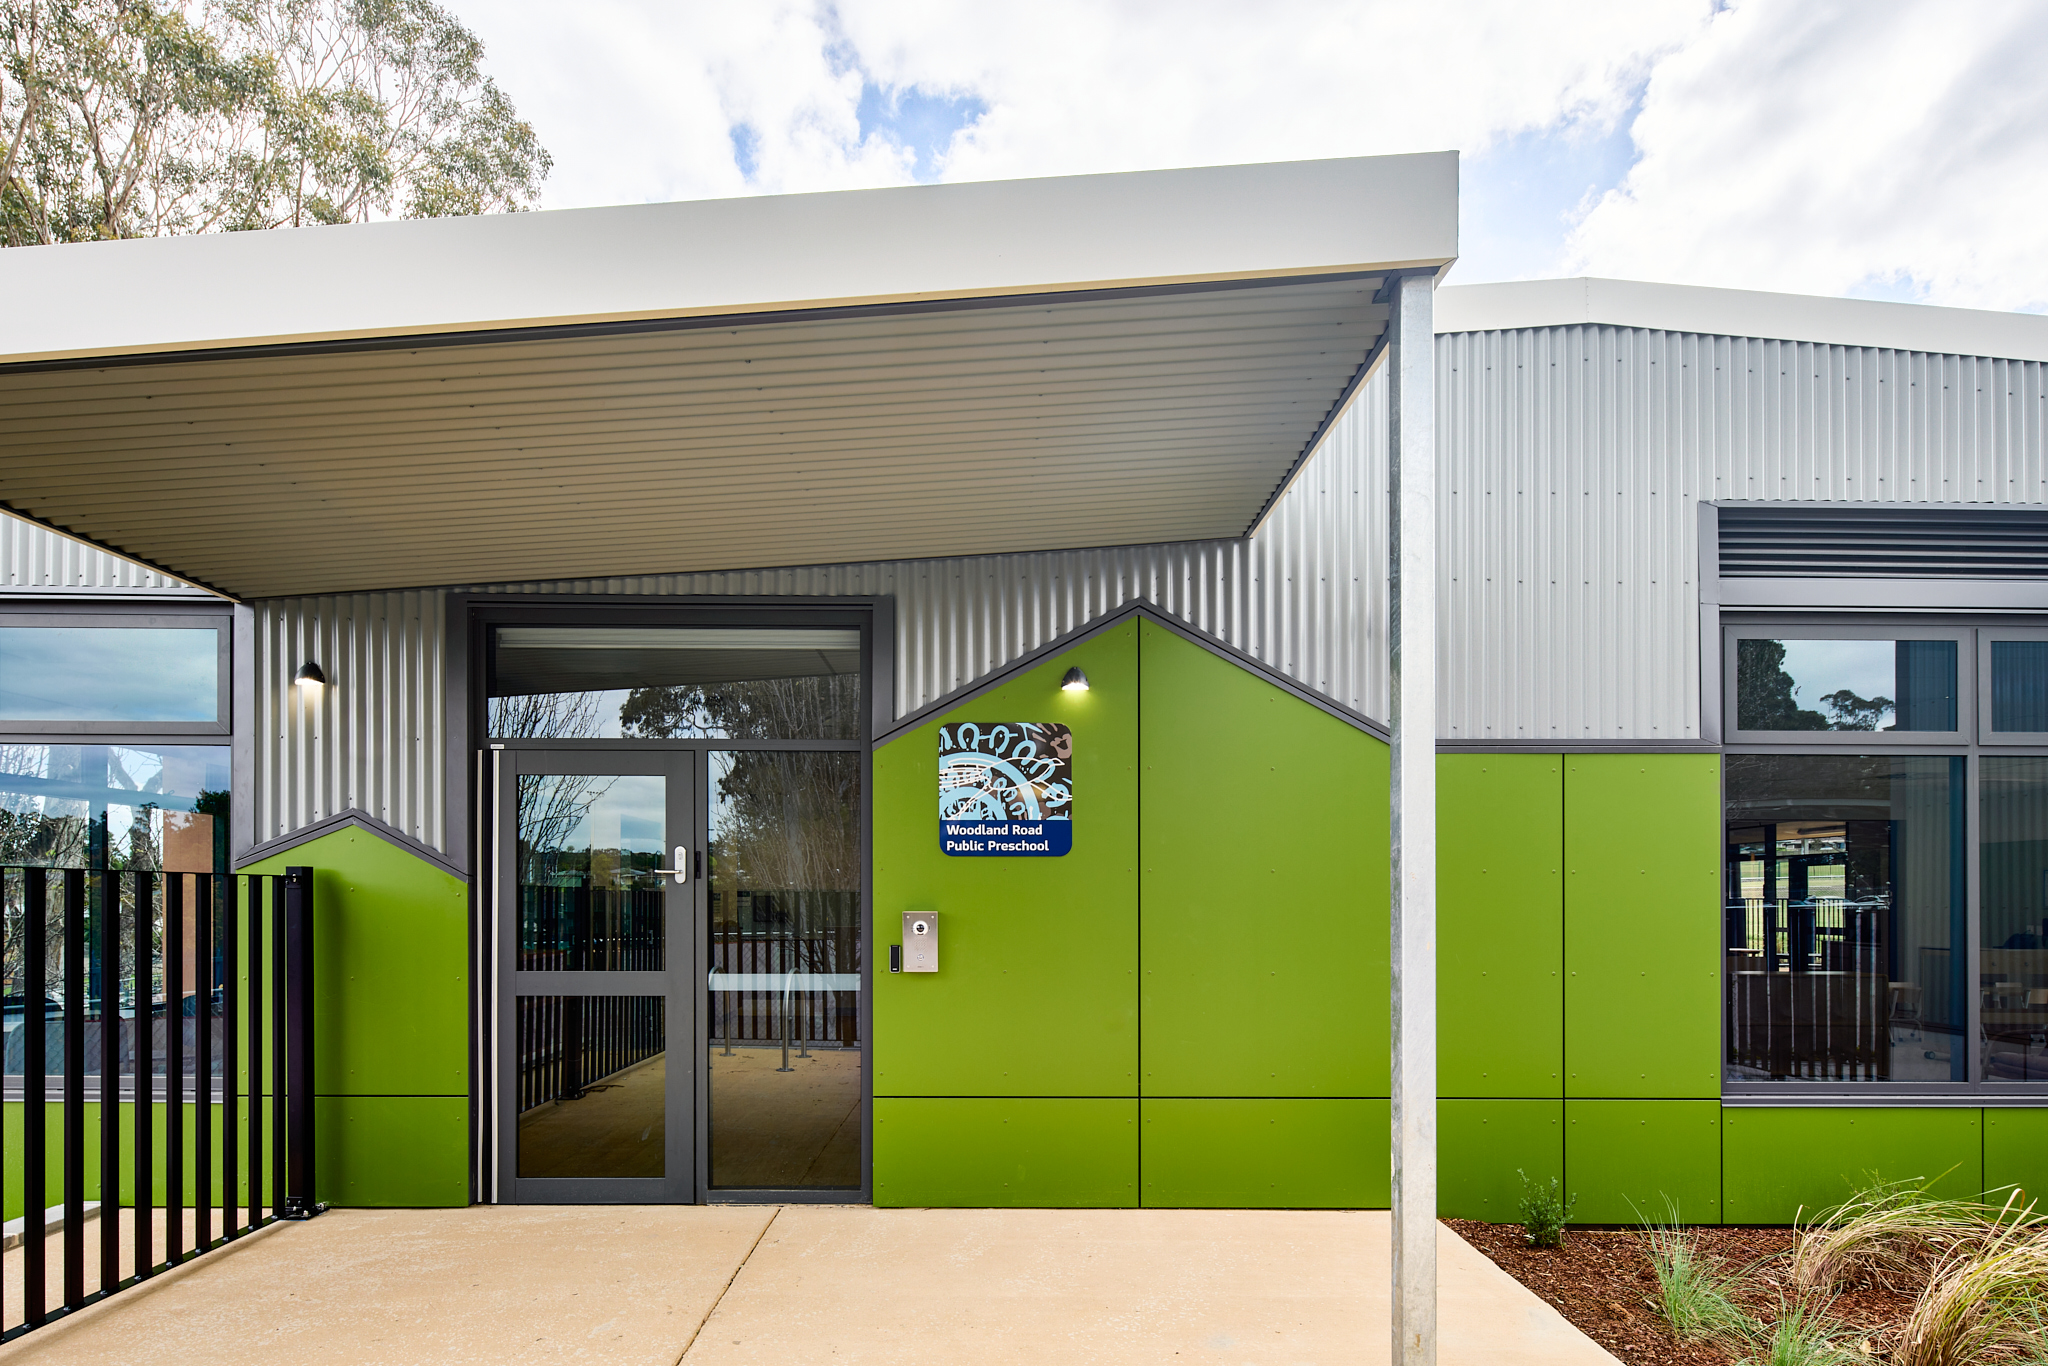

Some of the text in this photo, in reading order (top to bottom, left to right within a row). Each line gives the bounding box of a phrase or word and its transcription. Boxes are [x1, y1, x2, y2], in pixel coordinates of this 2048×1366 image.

[946, 824, 1043, 835] Woodland Road
[946, 840, 1049, 851] Public Preschool
